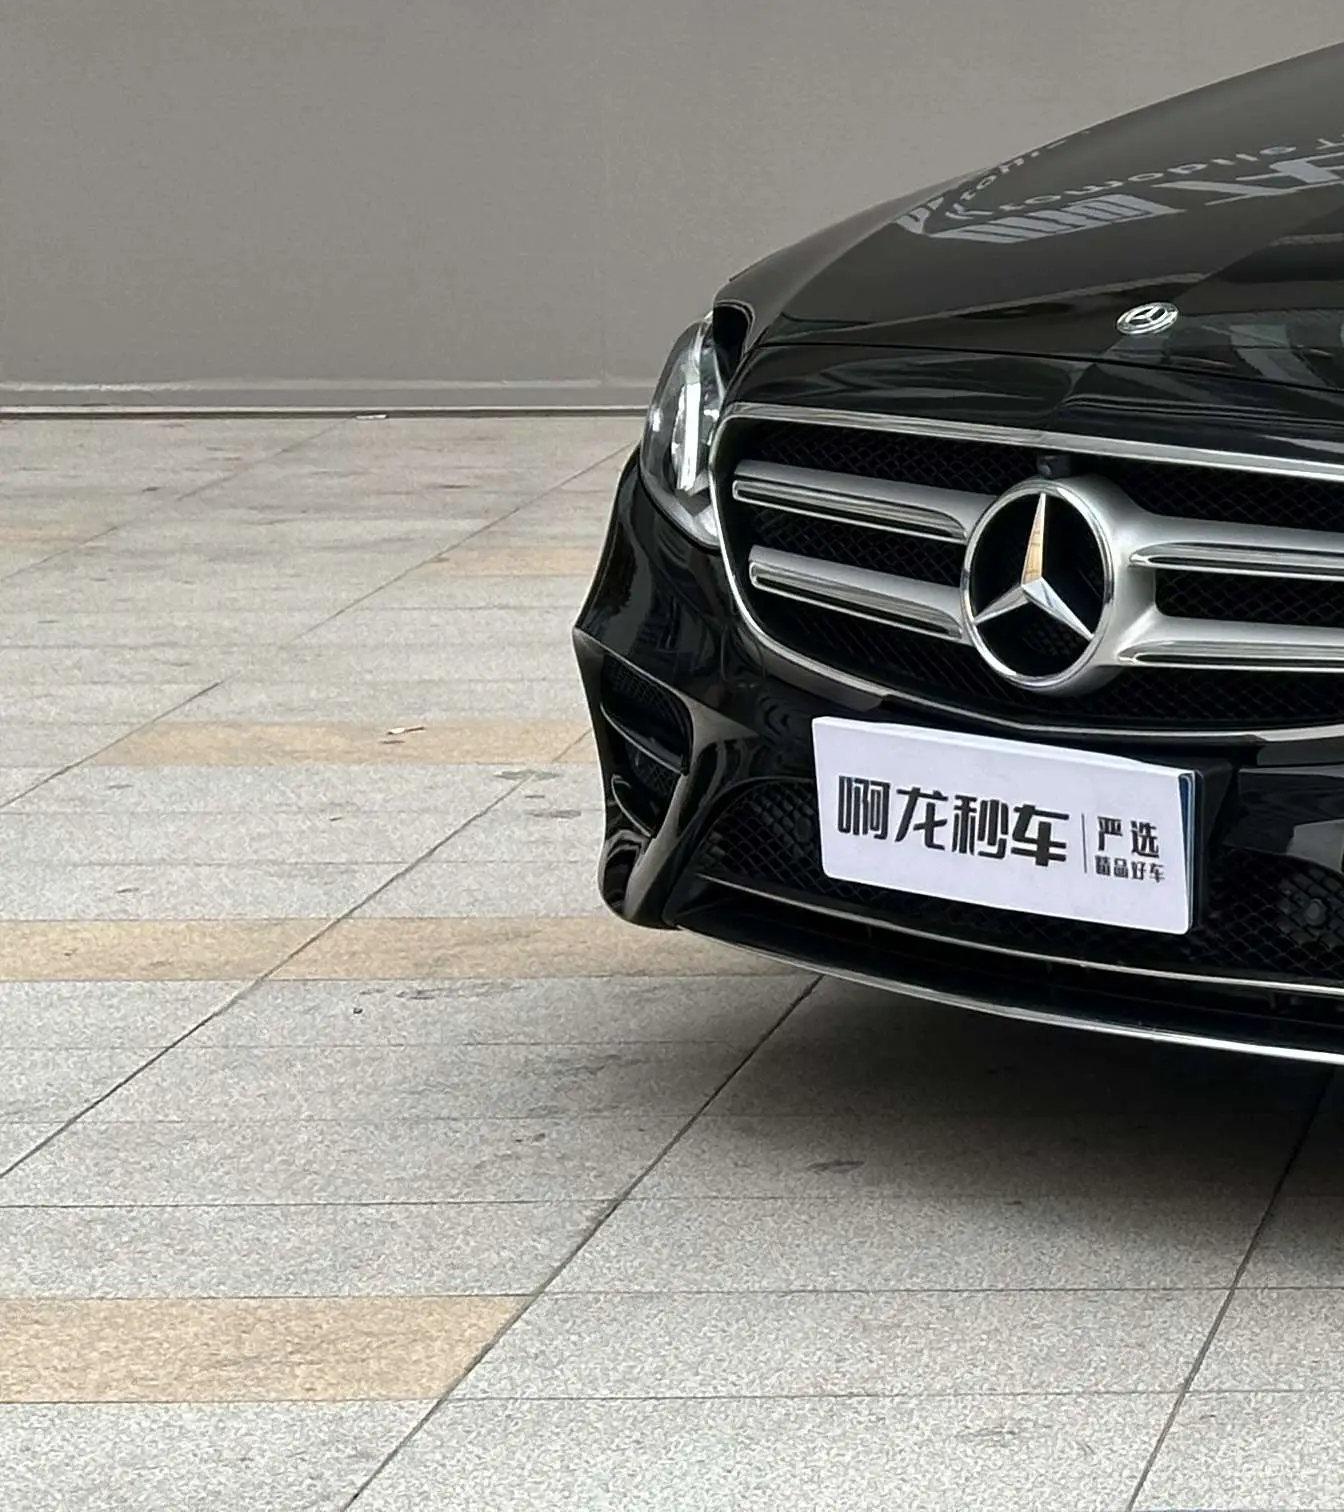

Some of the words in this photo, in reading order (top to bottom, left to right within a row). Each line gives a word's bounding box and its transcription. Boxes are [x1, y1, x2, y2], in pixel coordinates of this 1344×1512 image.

[838, 776, 1070, 867] 啊龙秒车
[1097, 816, 1160, 859] 严选
[1095, 855, 1166, 883] 精品好车
